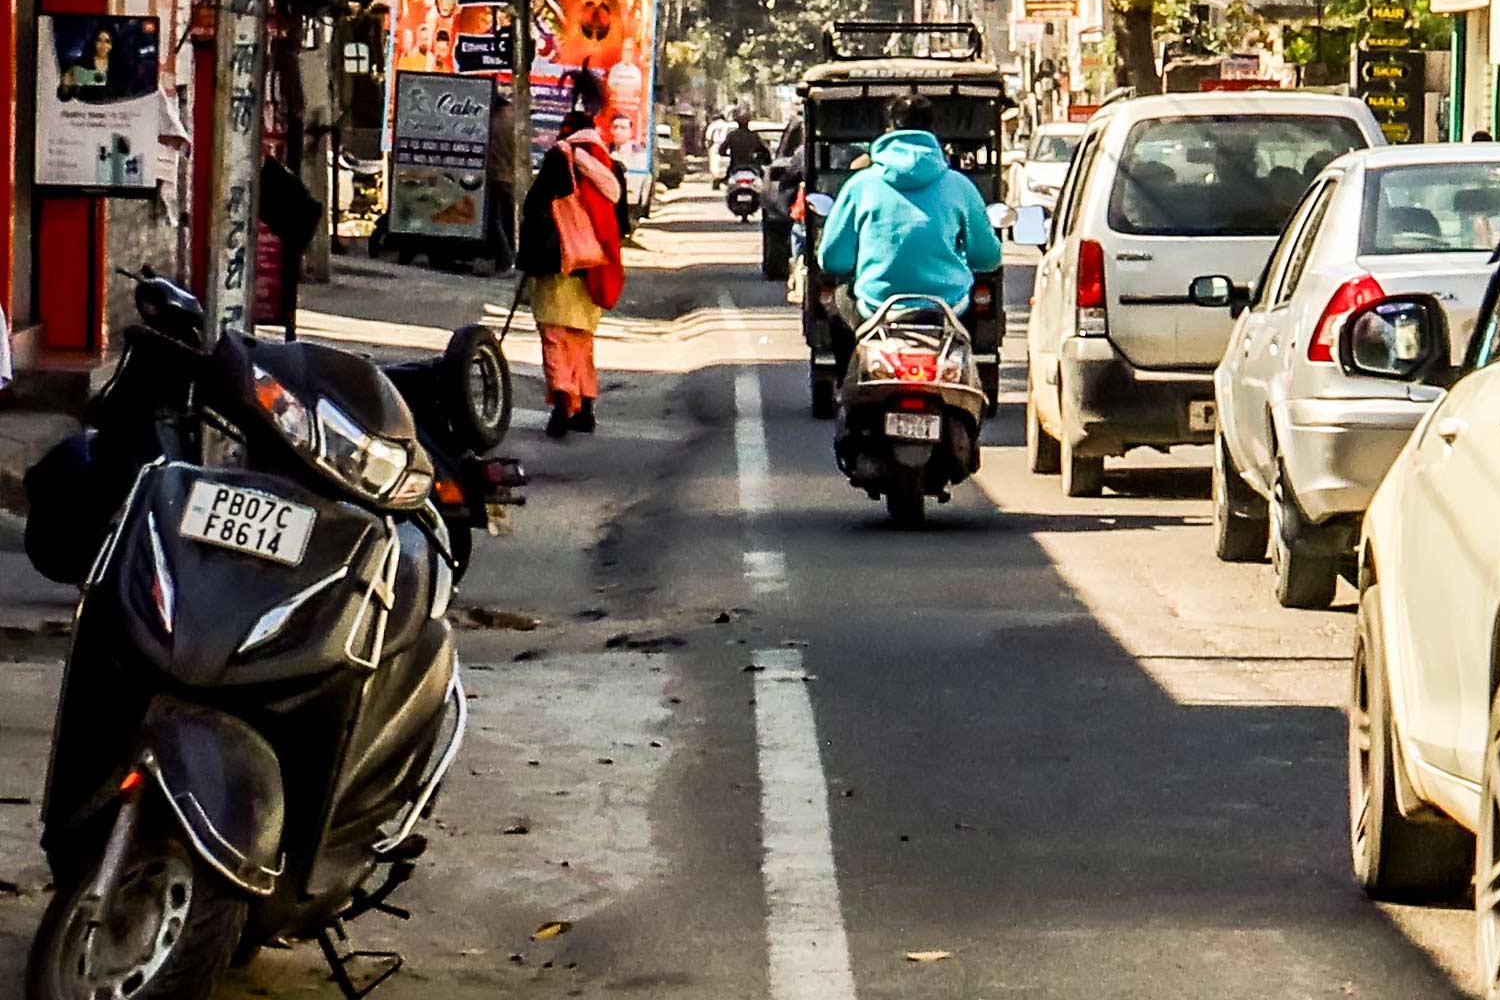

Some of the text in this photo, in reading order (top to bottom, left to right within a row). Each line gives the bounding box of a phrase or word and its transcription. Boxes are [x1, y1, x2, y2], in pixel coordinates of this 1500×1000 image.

[1372, 7, 1406, 19] HAIR
[211, 488, 292, 529] PB07C
[203, 513, 282, 554] F8614
